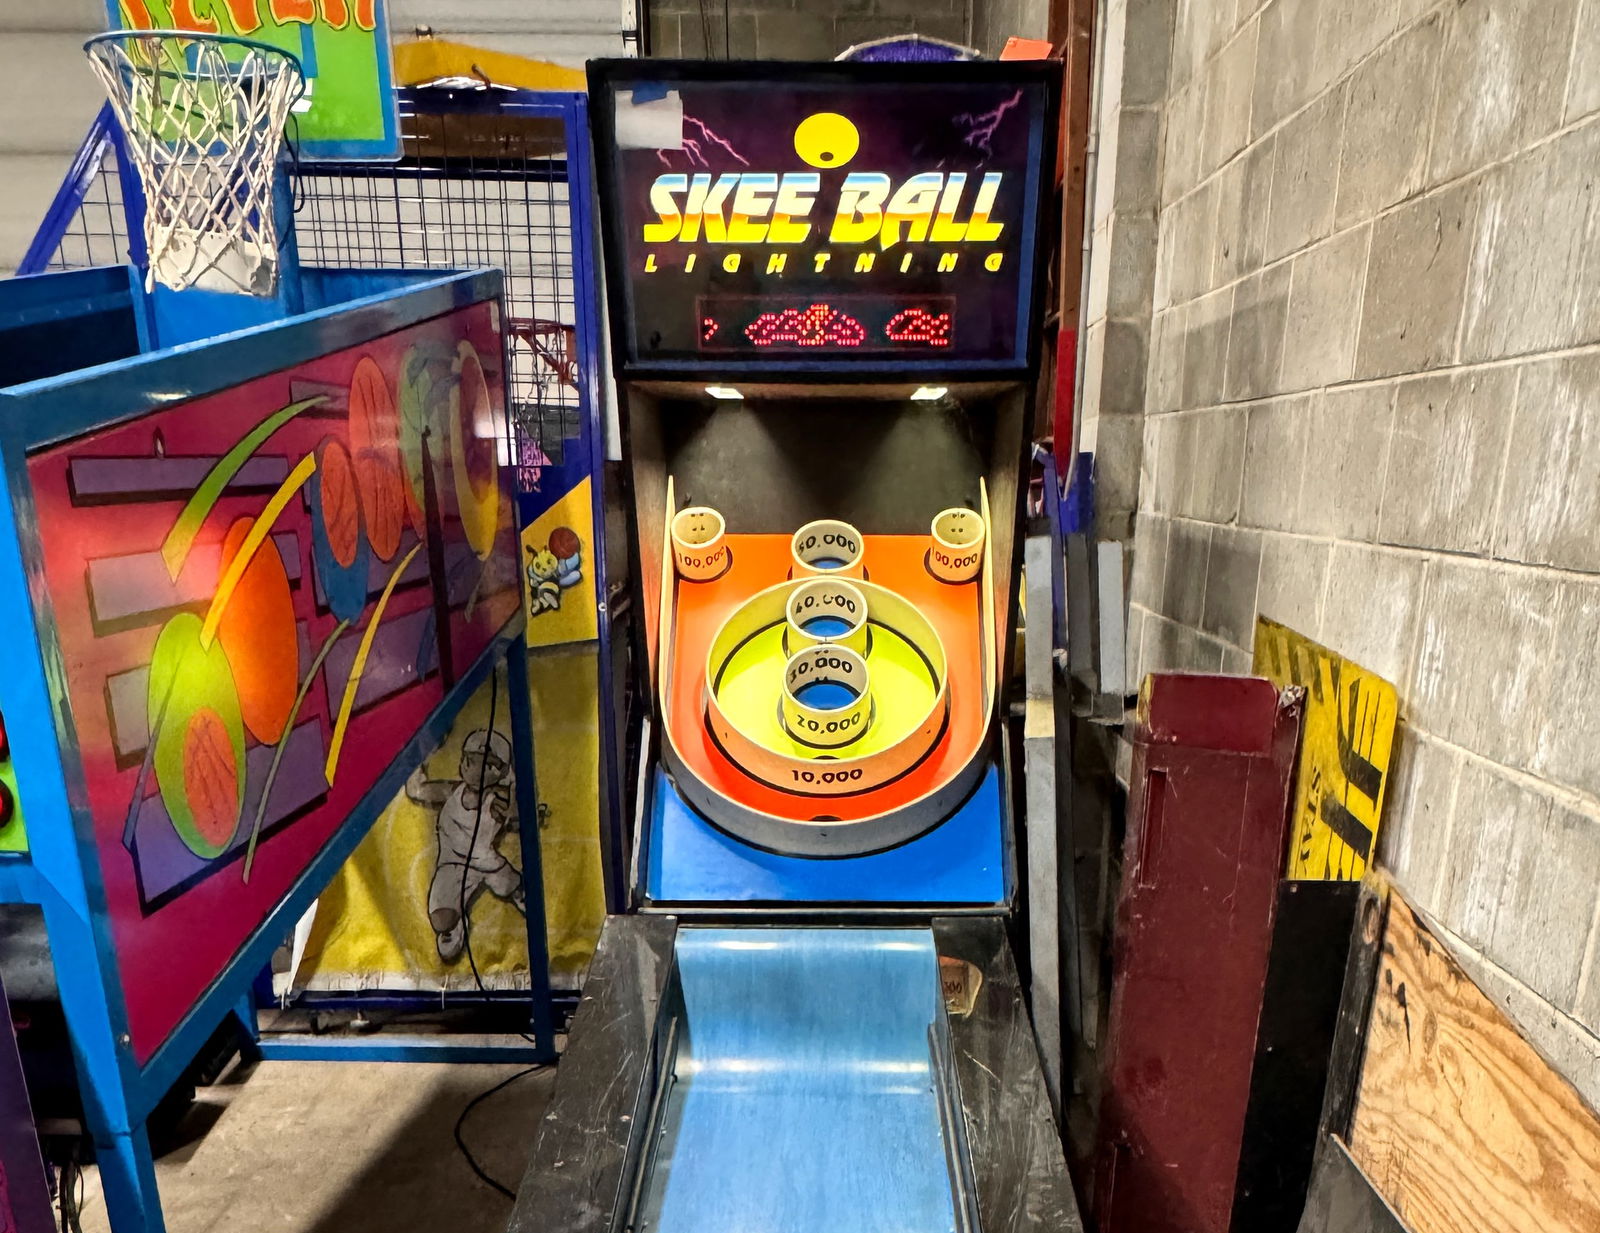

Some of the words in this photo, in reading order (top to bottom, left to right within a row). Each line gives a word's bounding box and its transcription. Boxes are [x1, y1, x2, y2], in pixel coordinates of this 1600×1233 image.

[643, 172, 820, 243] SKEE
[829, 172, 1004, 250] BALL
[644, 253, 1003, 274] LIGHTNING
[797, 712, 860, 734] 20,000
[792, 768, 862, 785] 10,000
